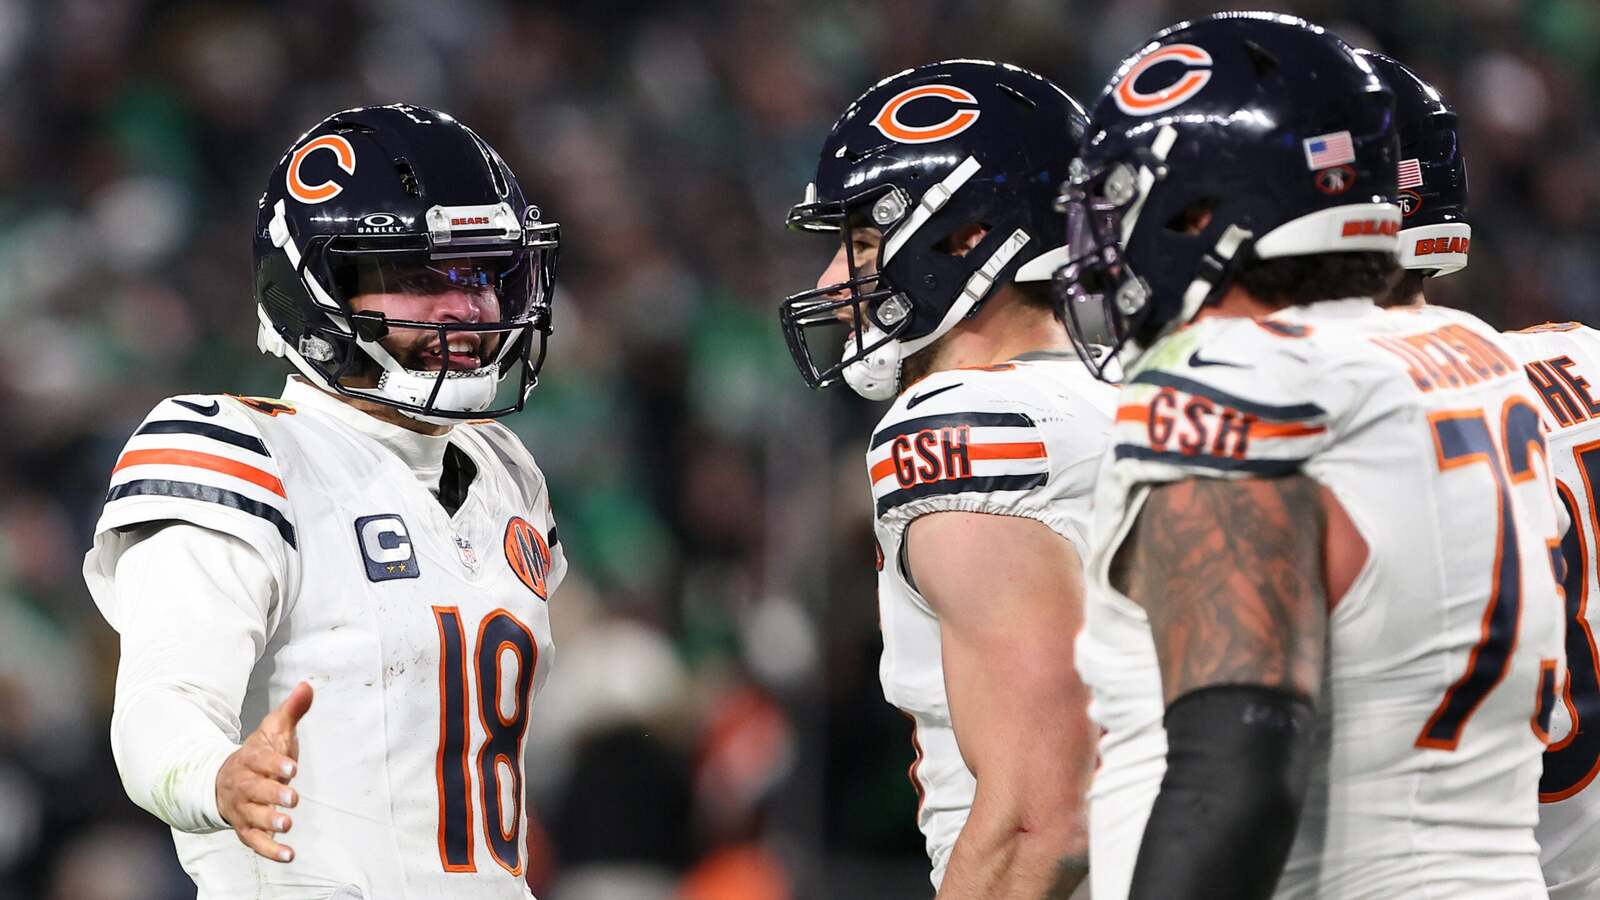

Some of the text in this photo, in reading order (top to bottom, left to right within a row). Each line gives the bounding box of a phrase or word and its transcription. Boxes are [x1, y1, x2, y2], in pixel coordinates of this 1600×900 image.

[451, 217, 489, 226] BEARS
[891, 425, 972, 489] GSH
[1148, 386, 1258, 460] GSH
[432, 605, 538, 877] 18
